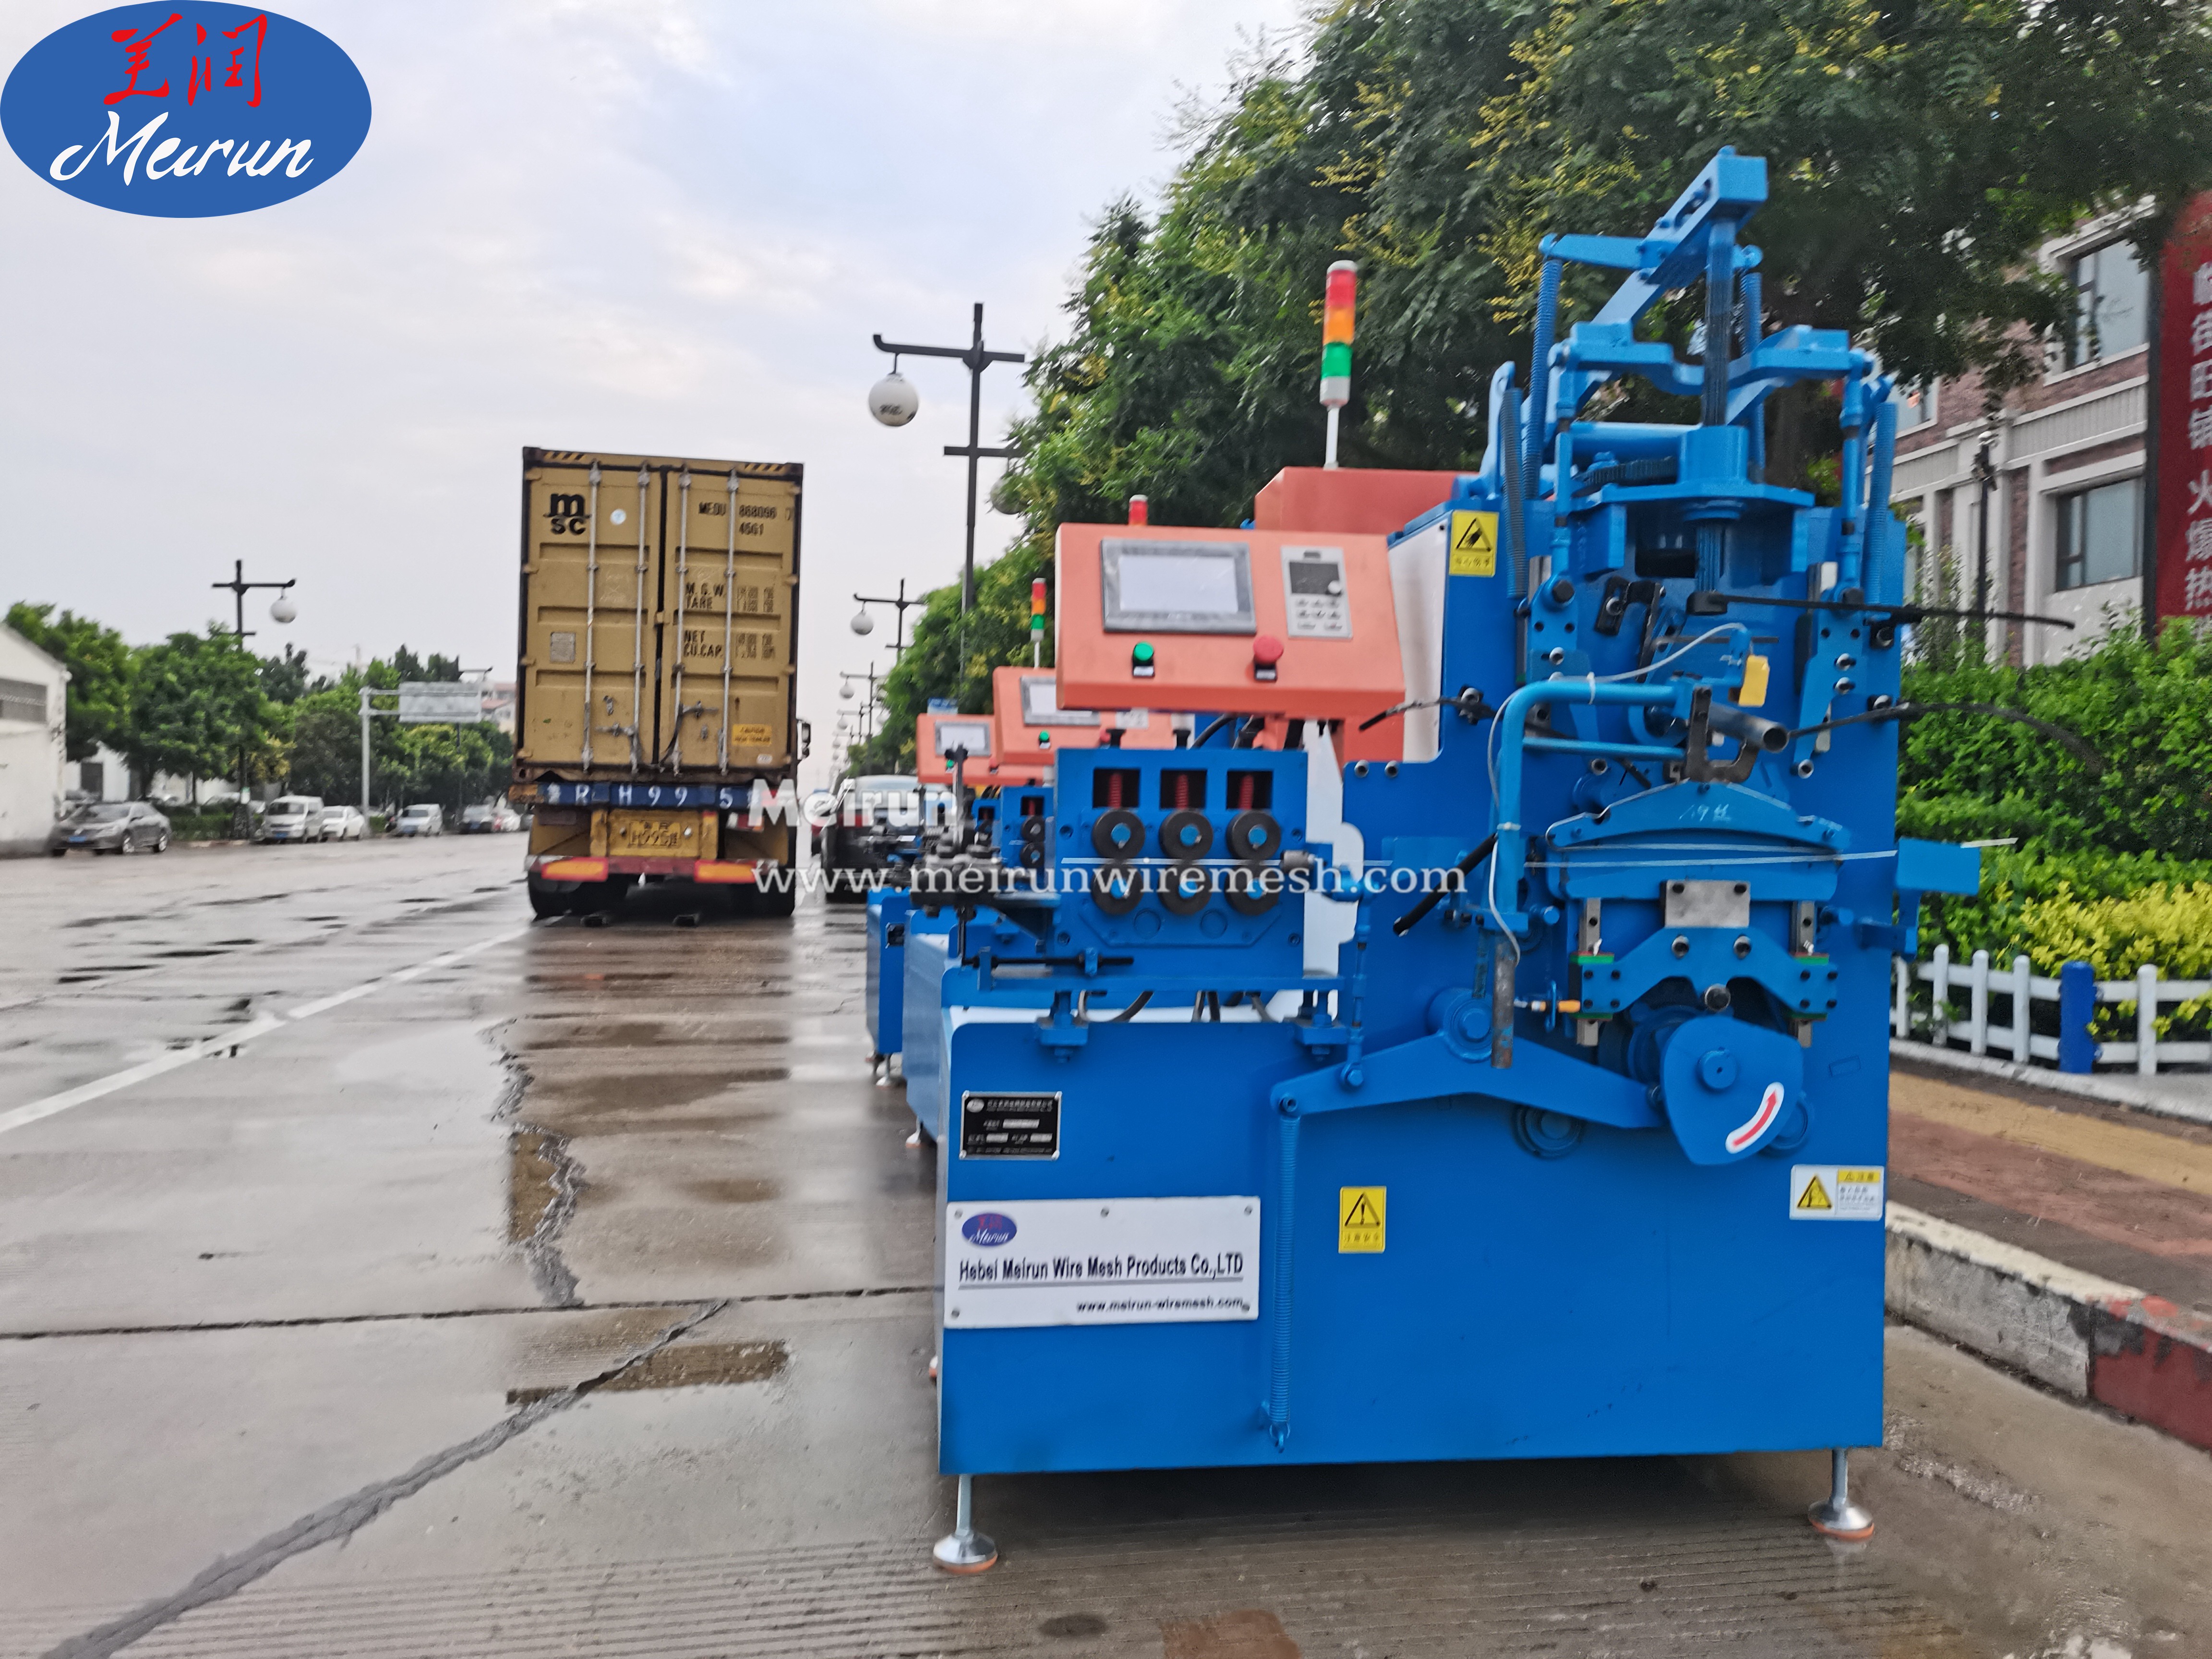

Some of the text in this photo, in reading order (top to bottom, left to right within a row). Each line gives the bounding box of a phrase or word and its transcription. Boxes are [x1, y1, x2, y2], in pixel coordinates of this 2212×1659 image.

[686, 596, 713, 609] TARE
[684, 630, 705, 643] NET
[959, 1251, 1243, 1282] Hebei Meirun Wire Mesh Products Co.,LTD
